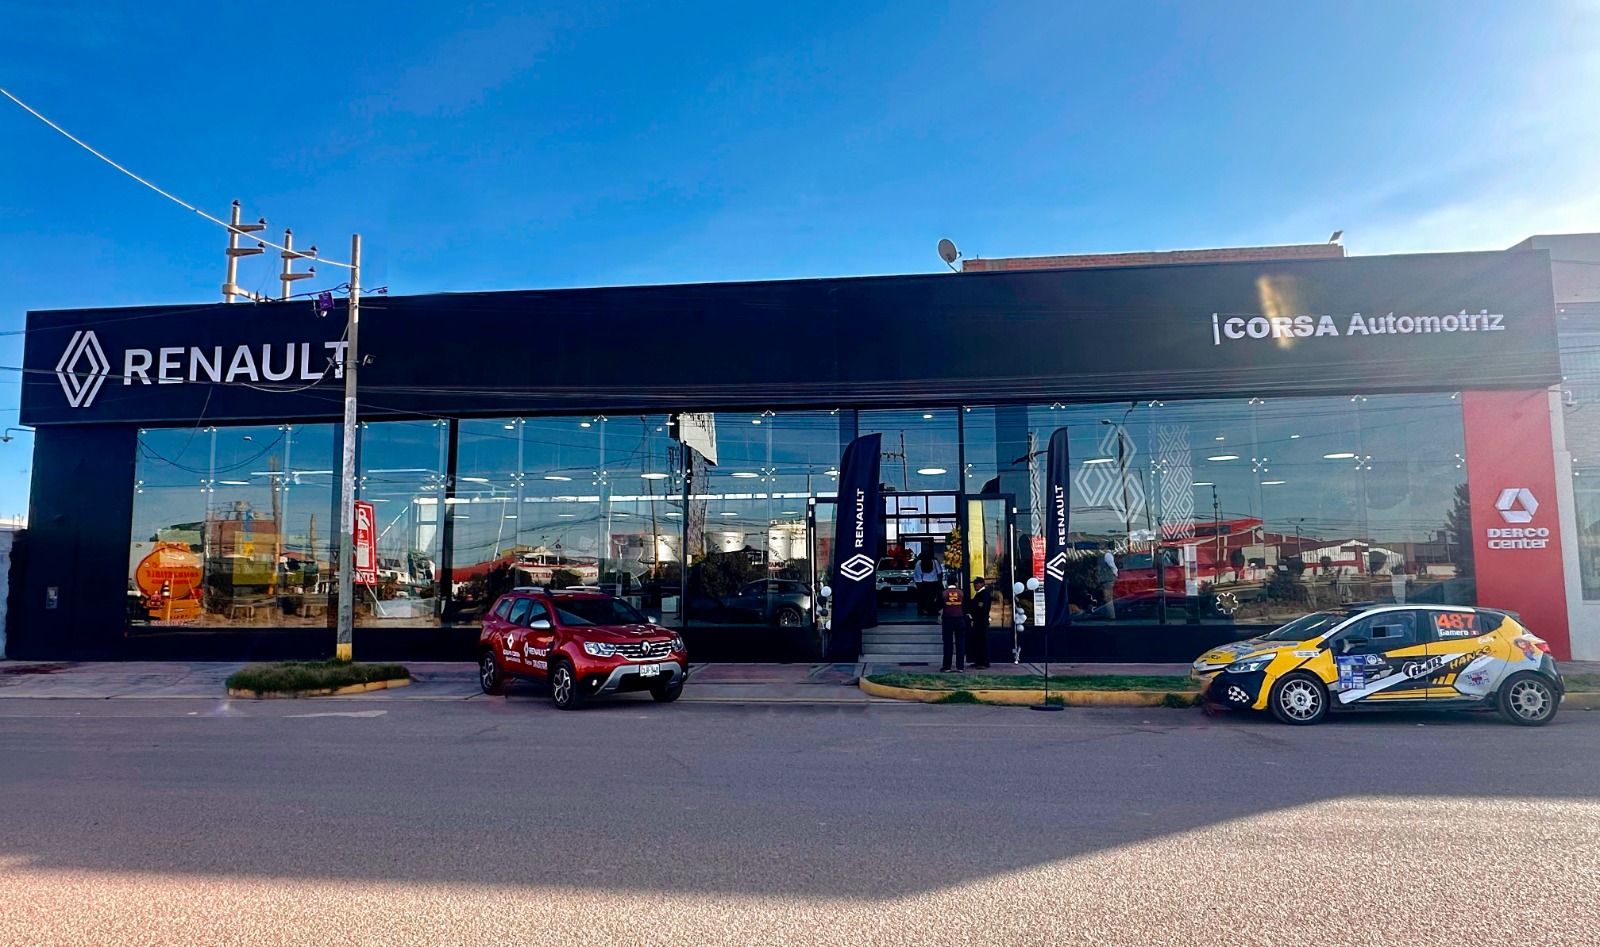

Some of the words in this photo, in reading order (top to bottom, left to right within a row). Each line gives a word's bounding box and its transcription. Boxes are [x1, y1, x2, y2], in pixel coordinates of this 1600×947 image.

[1224, 314, 1339, 339] CORSA
[1347, 309, 1505, 335] Automotriz
[123, 341, 349, 386] RENAULT
[854, 488, 865, 548] RENAULT
[1054, 484, 1066, 546] RENAULT
[1486, 527, 1549, 538] DERCO
[1487, 538, 1549, 549] center
[1437, 613, 1475, 629] 487
[1439, 628, 1469, 637] Gamero
